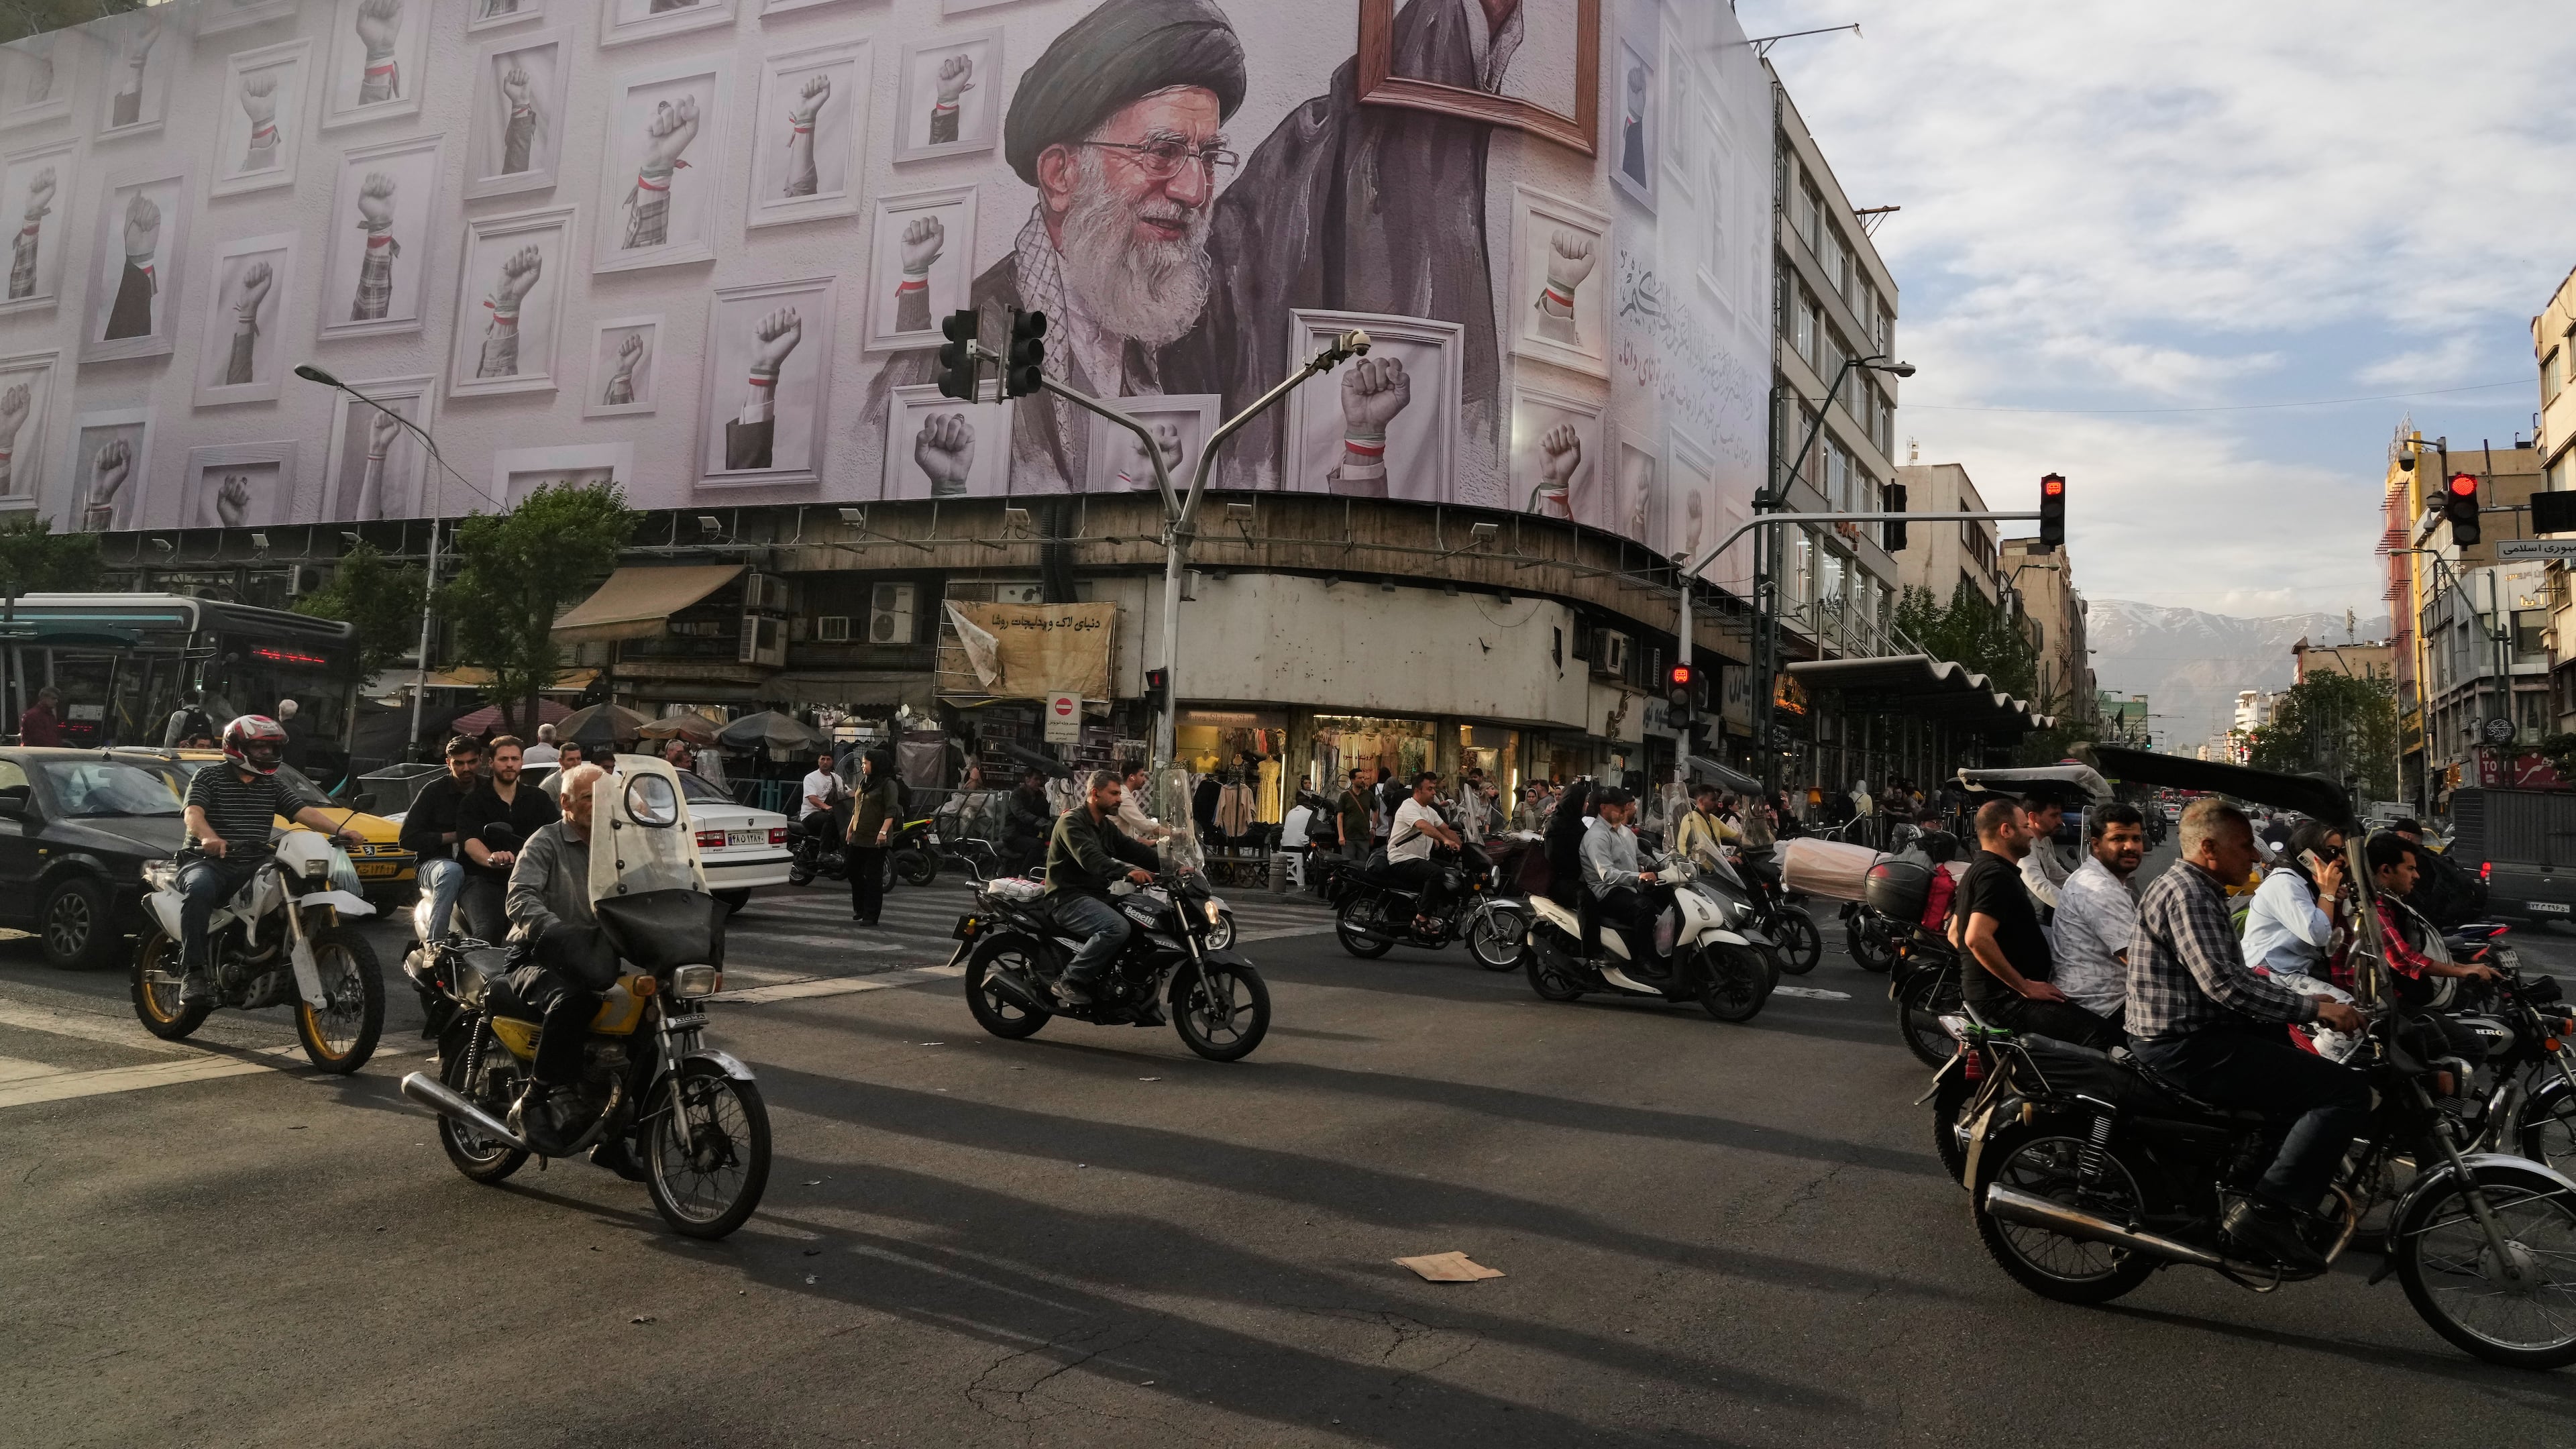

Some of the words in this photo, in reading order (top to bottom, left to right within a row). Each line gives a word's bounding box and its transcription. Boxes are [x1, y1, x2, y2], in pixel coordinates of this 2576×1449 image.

[2503, 544, 2542, 555] اسلامی
[991, 613, 1009, 631] روشا
[1055, 614, 1073, 629] لاک
[1074, 616, 1101, 632] دنیای
[1210, 713, 1232, 722] Shiva
[1124, 905, 1155, 926] Benelli
[676, 1014, 705, 1023] XIGMA
[2475, 1028, 2504, 1037] HRO
